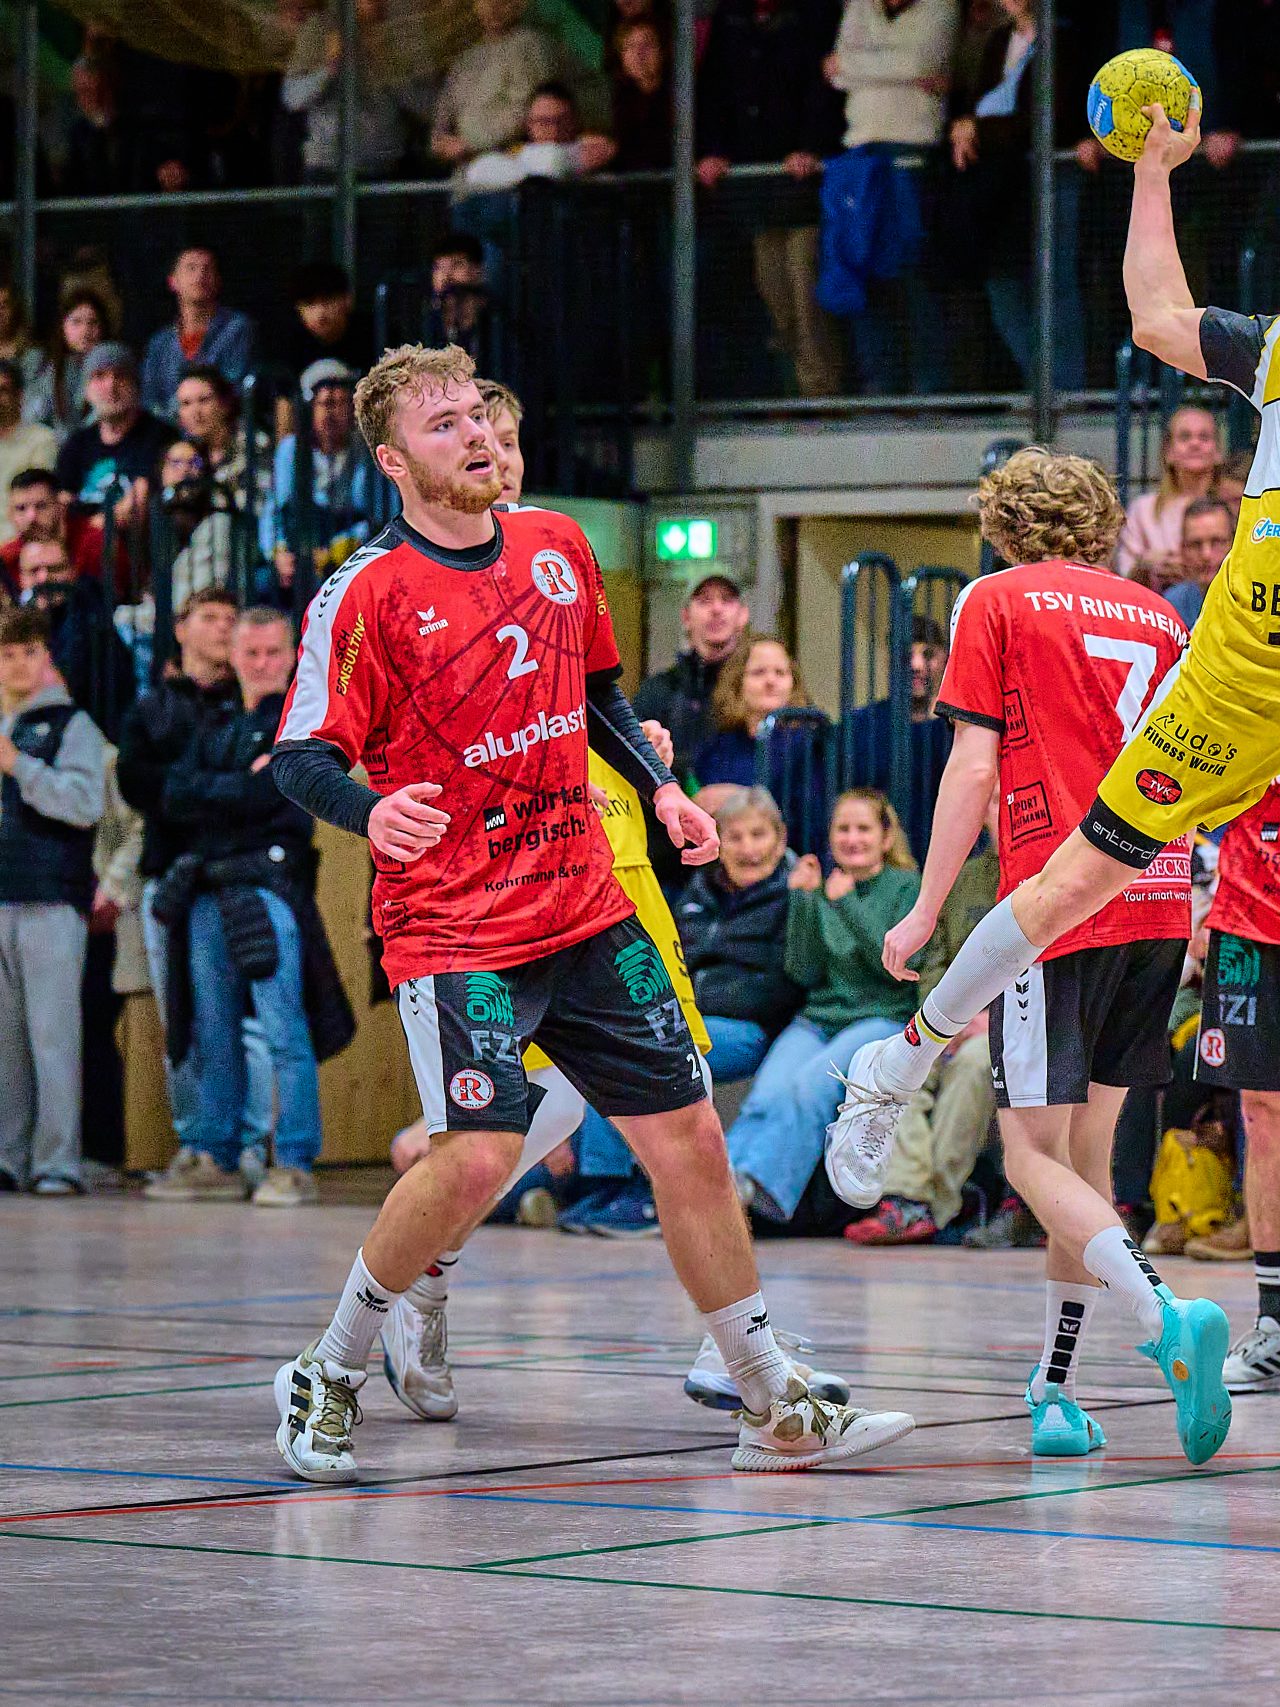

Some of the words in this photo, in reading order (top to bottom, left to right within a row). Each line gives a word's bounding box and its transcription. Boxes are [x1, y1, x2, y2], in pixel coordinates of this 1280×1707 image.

[418, 619, 449, 636] erima
[1024, 590, 1074, 612] TSV
[1079, 595, 1188, 647] RINTHEIM
[496, 624, 539, 680] 2
[1082, 633, 1157, 743] 7
[463, 704, 586, 768] aluplast
[1143, 725, 1186, 762] Fitness
[1189, 755, 1227, 777] World
[1150, 780, 1172, 796] TVK
[488, 814, 586, 860] bergisch
[558, 865, 569, 879] &
[1122, 890, 1146, 902] Your
[1148, 890, 1173, 901] smart
[686, 1053, 701, 1080] 2
[356, 1291, 389, 1313] erima
